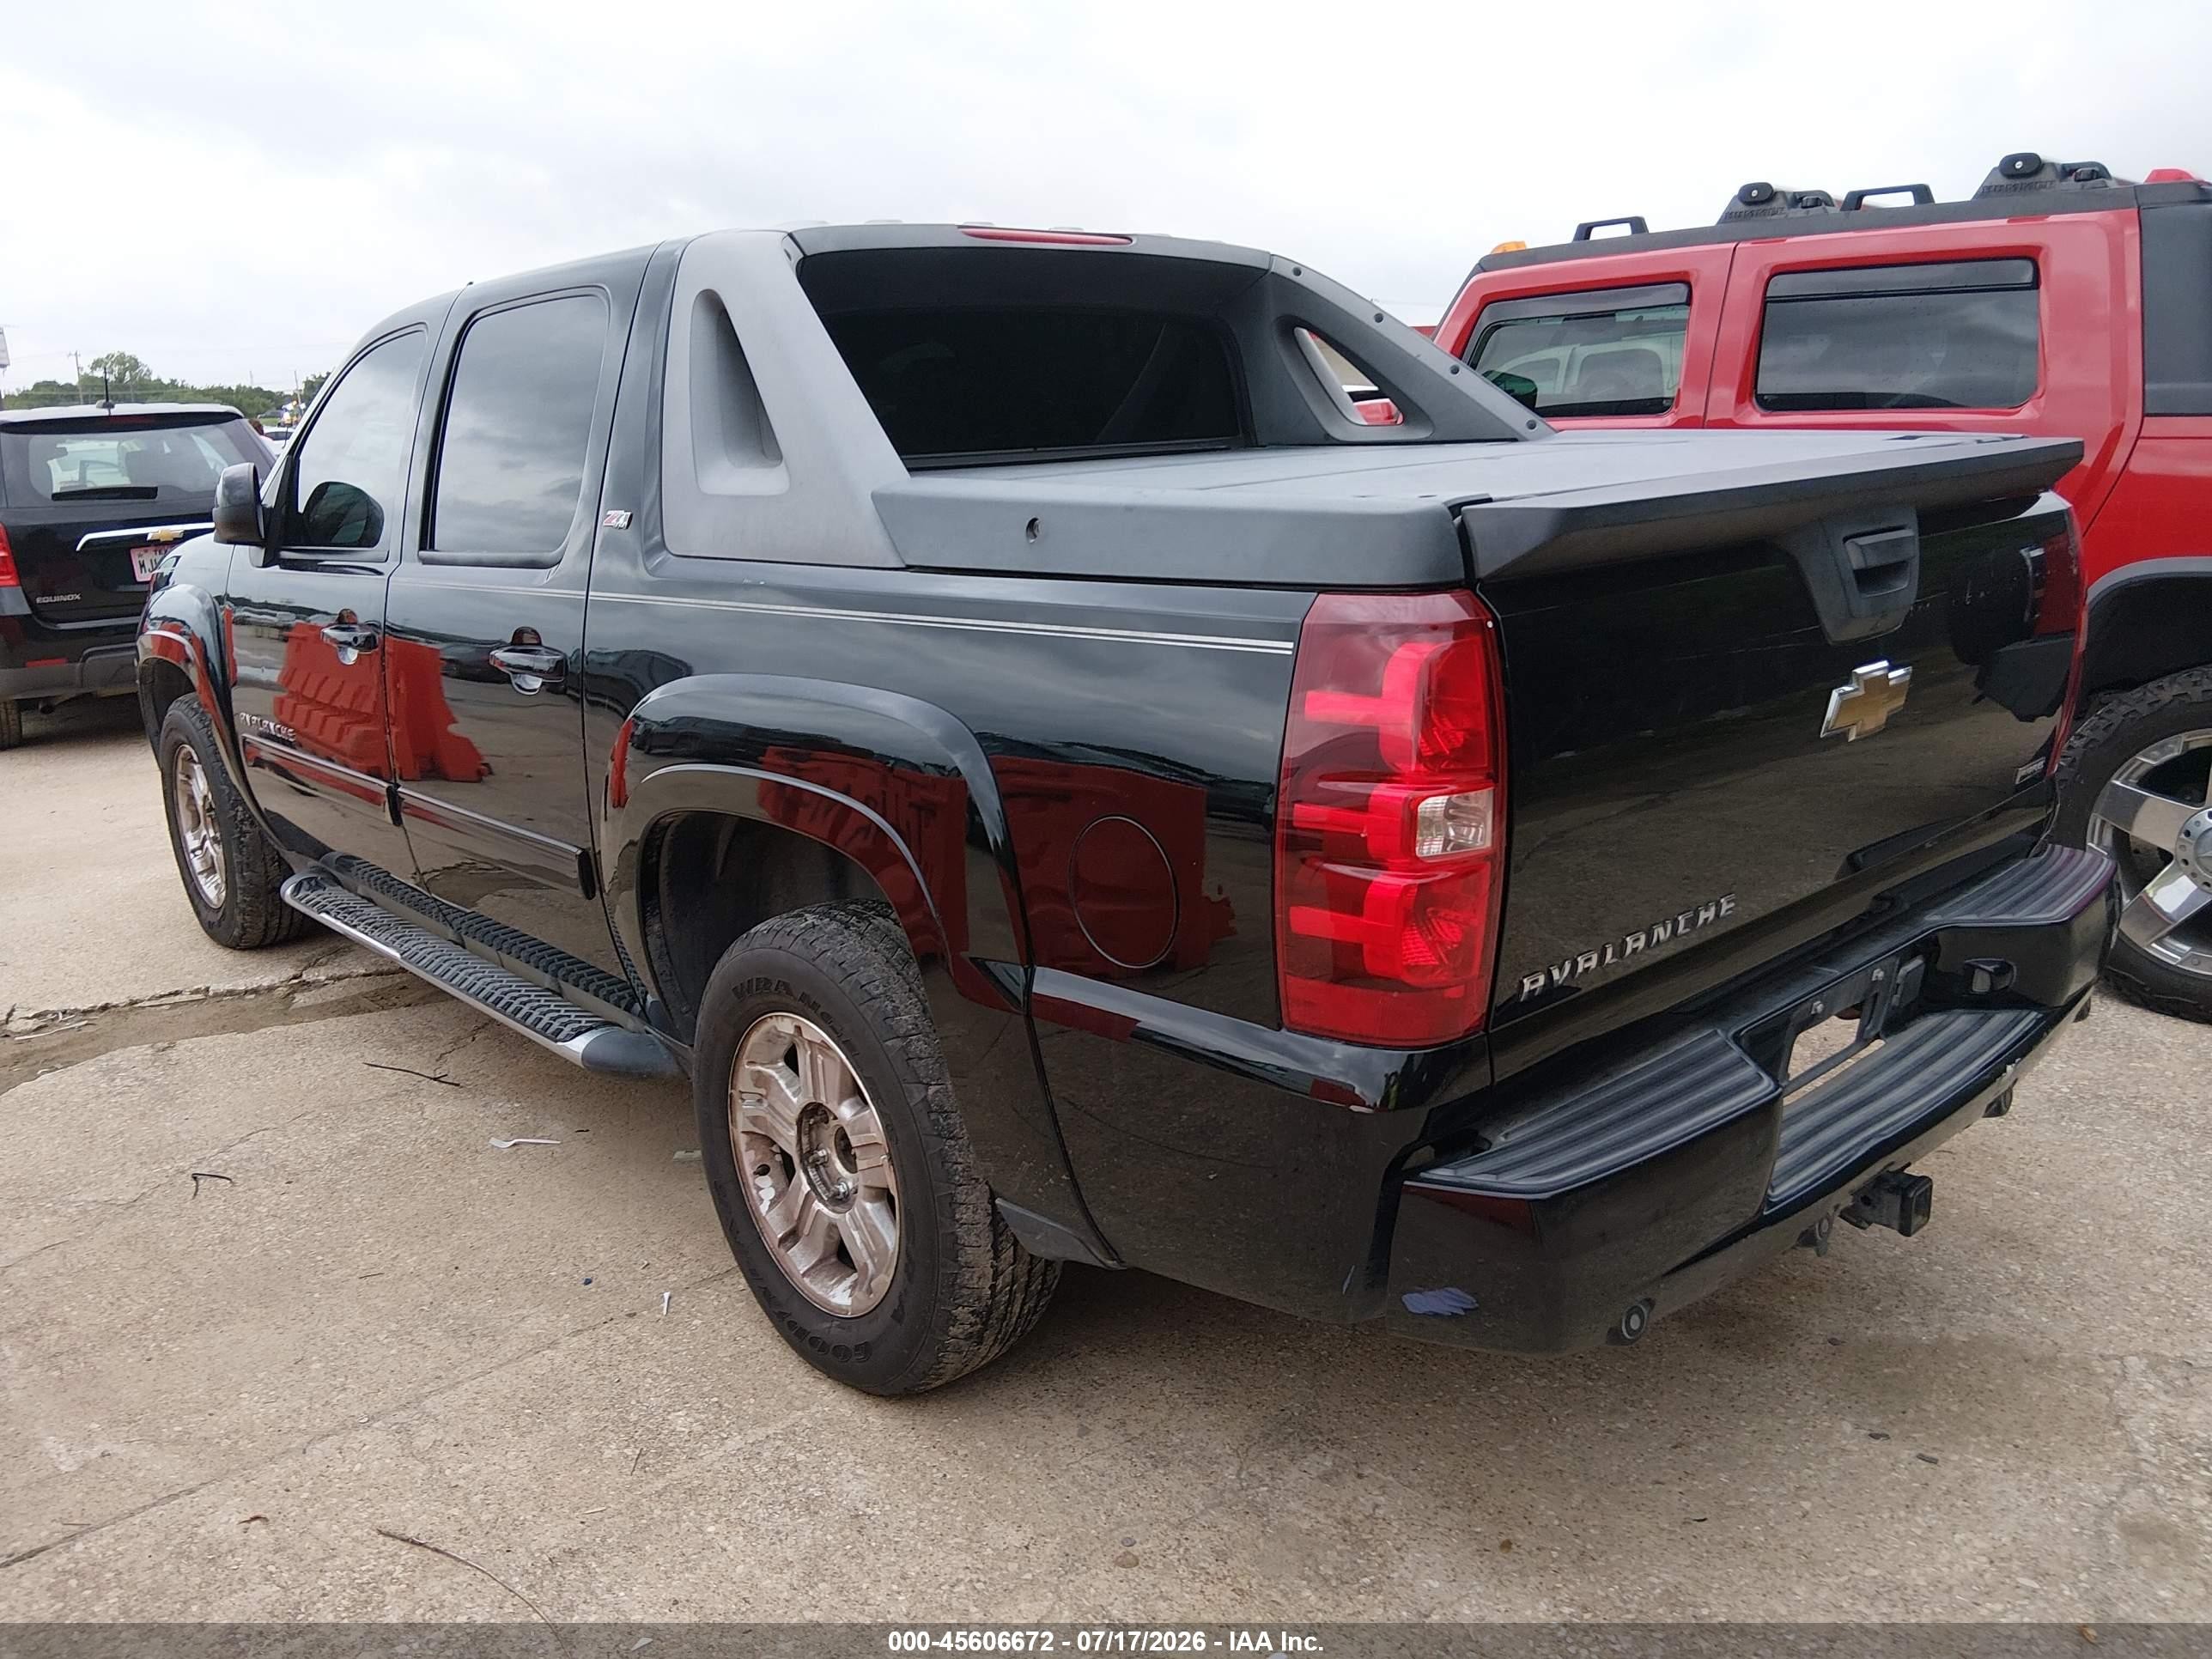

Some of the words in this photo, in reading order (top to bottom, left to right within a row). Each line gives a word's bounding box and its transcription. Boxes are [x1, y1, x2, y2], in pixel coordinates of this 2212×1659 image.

[36, 592, 82, 604] EQUINOX
[240, 712, 296, 742] AVALANCHE
[1516, 893, 1736, 1002] AVALANCHE
